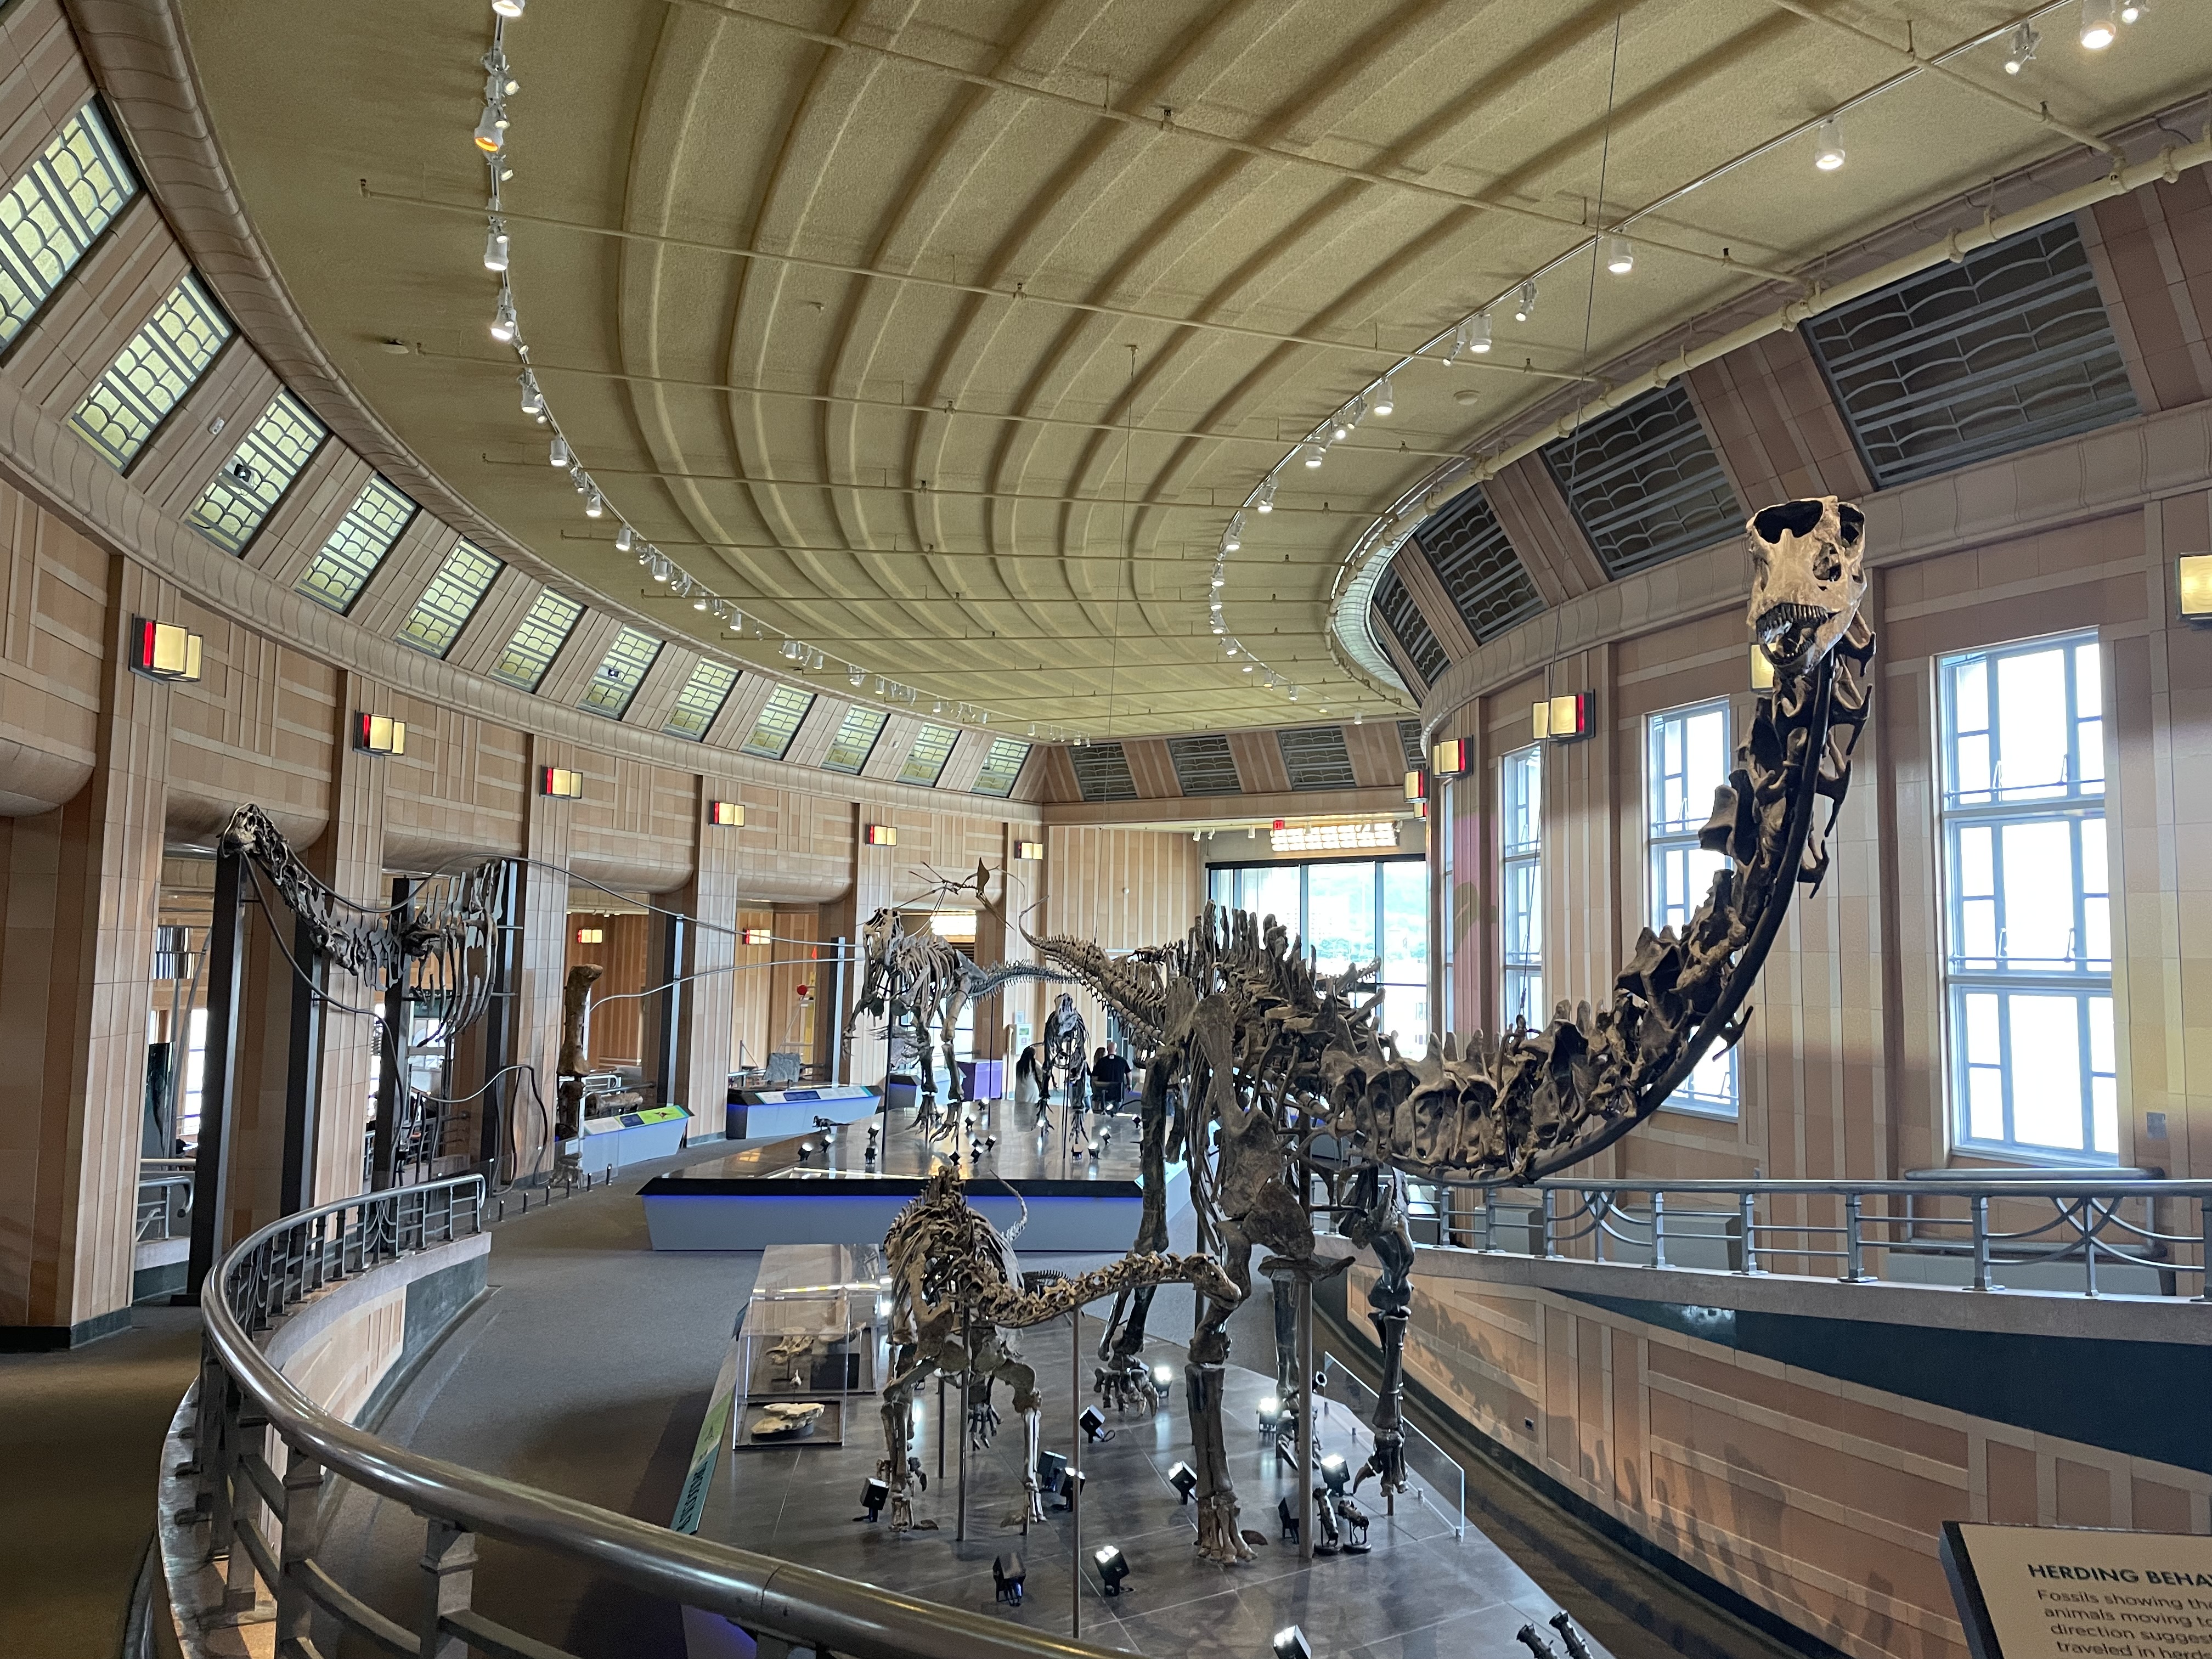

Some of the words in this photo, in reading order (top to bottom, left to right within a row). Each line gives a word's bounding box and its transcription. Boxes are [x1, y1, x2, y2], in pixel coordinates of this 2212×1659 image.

[2028, 1564, 2138, 1583] HERDING
[2146, 1570, 2212, 1587] BEHA
[2038, 1589, 2099, 1603] Fossils
[2104, 1593, 2183, 1610] showing
[2045, 1608, 2115, 1621] animals
[2121, 1612, 2192, 1628] moving
[2051, 1623, 2135, 1639] direction
[2057, 1641, 2132, 1656] traveled
[2136, 1646, 2155, 1658] in
